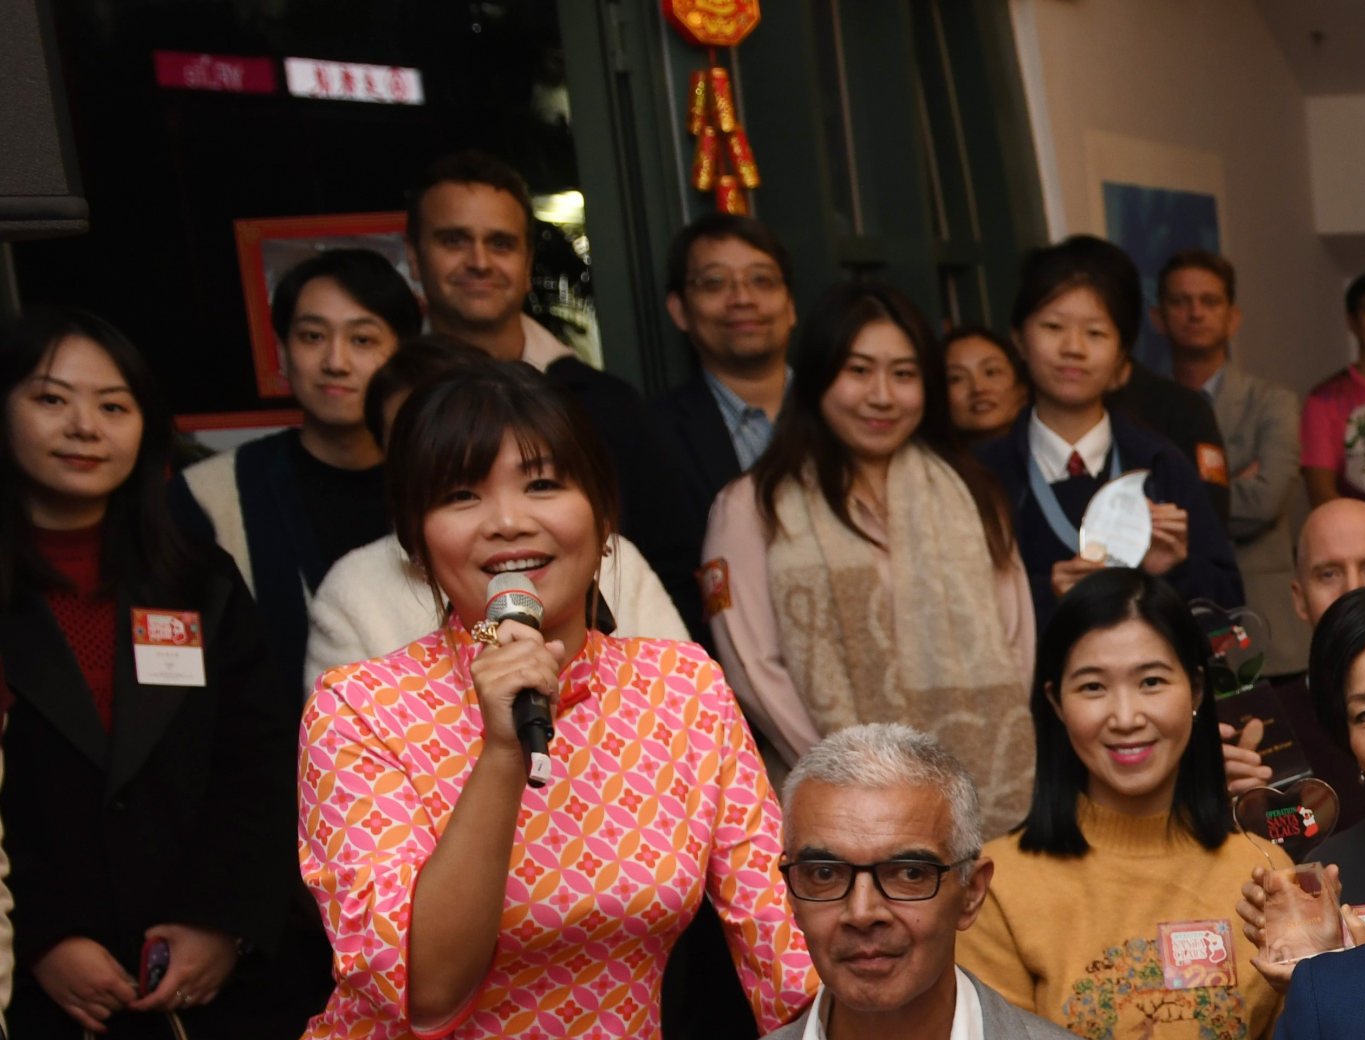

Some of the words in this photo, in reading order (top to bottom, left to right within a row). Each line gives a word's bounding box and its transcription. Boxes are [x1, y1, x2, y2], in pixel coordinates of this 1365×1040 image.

[1266, 806, 1297, 817] OPERATION
[1267, 815, 1299, 829] SANTA
[1269, 824, 1301, 838] CLAUS
